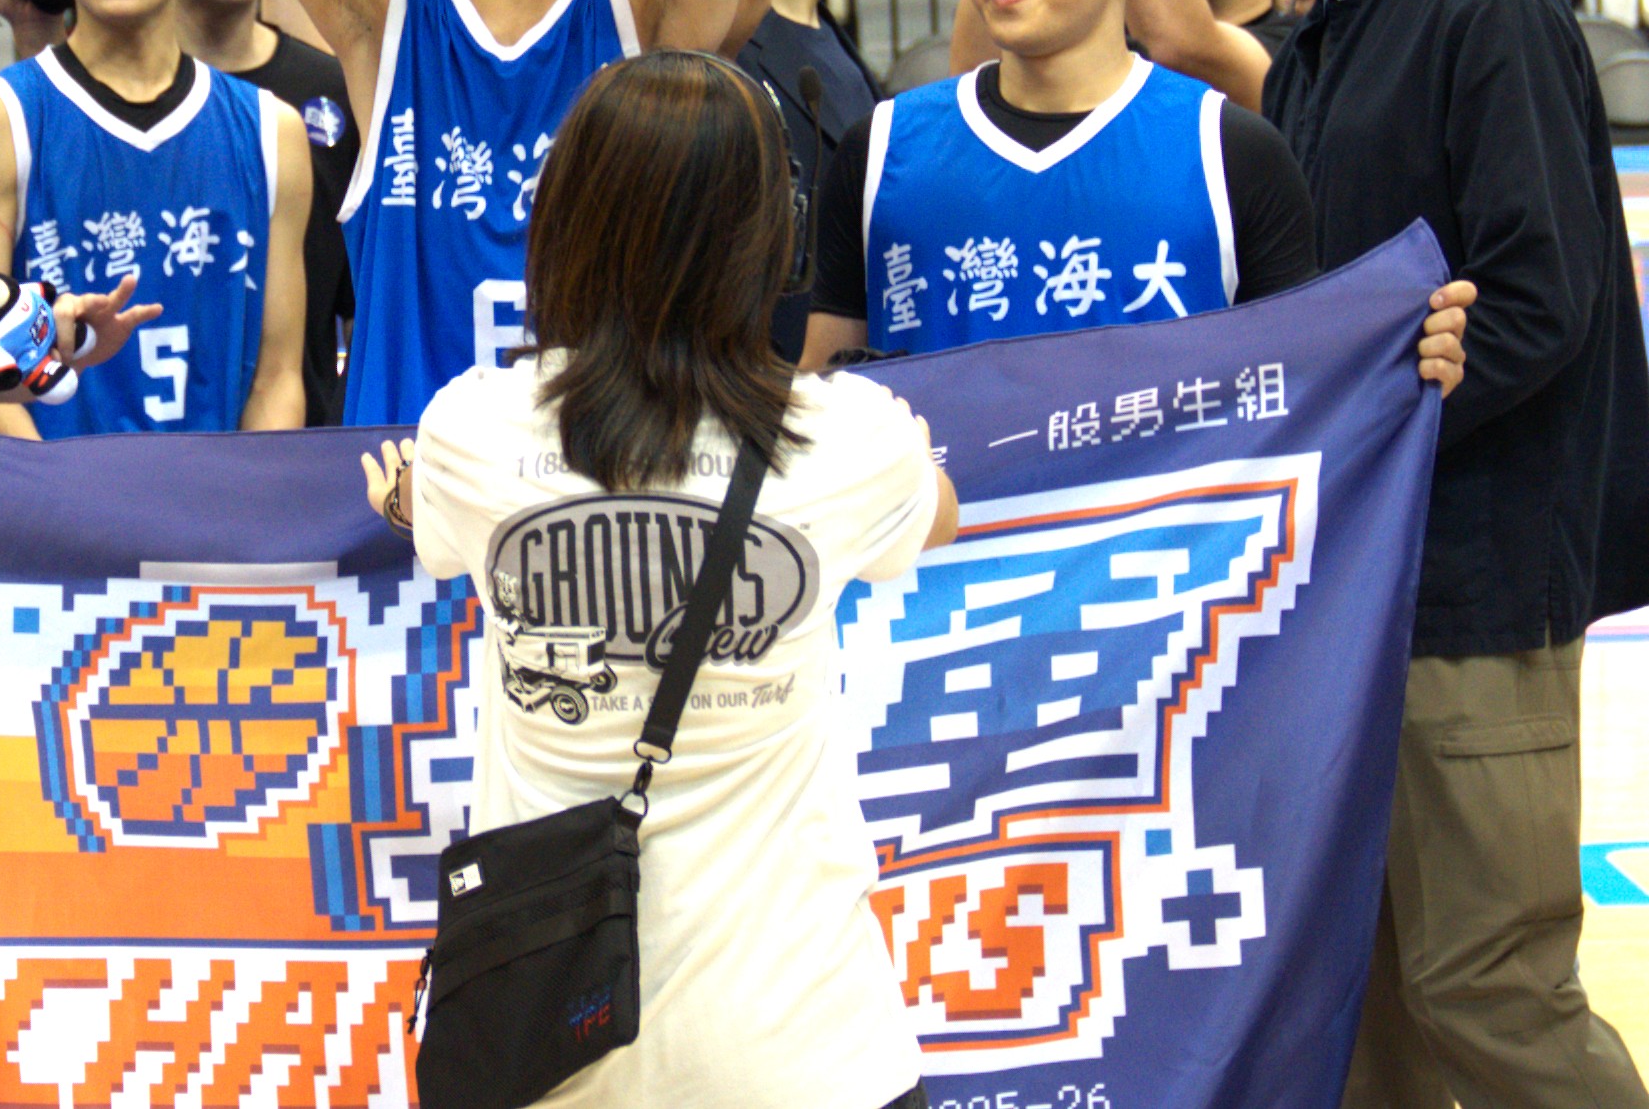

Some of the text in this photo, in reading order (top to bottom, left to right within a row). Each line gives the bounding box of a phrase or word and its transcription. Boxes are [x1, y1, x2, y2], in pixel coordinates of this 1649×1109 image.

[882, 235, 1189, 333] 臺灣海大
[138, 325, 190, 422] 5
[987, 362, 1289, 452] 一般男生組
[520, 511, 765, 646] GROUNS
[592, 695, 628, 711] TAKE
[633, 695, 643, 711] A
[691, 693, 712, 710] ON
[717, 691, 748, 708] OUR
[751, 673, 795, 708] Turf
